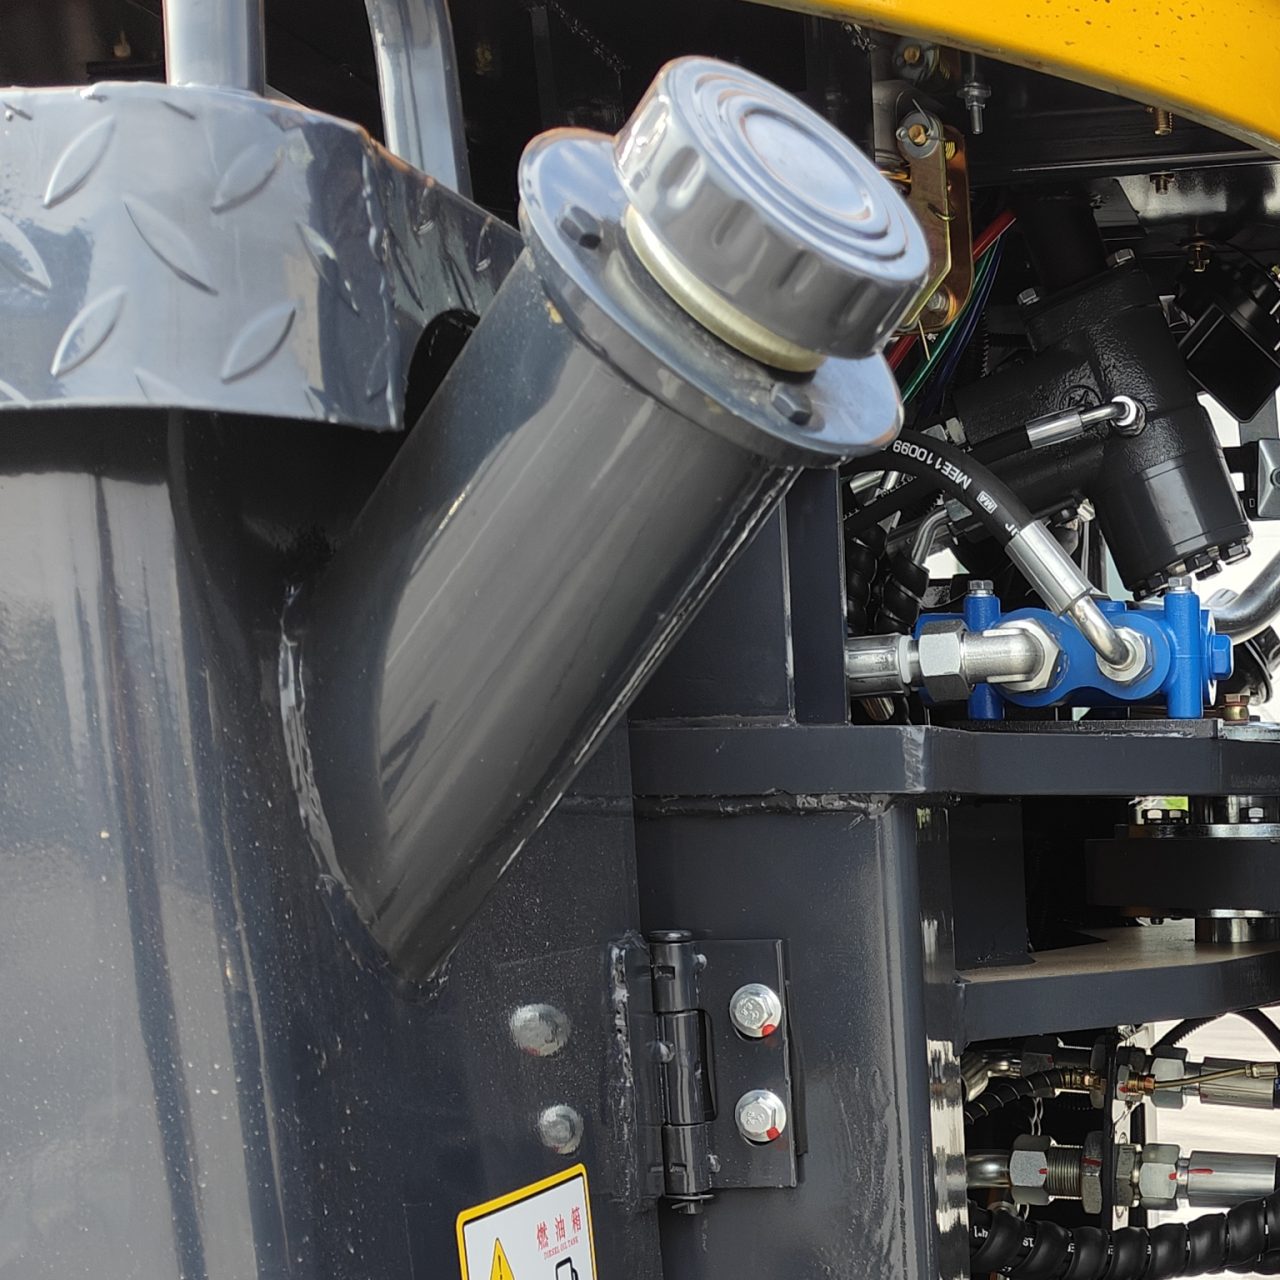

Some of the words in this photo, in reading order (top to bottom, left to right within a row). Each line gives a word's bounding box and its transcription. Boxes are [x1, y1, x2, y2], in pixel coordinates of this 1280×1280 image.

[893, 440, 972, 490] MEE110099
[537, 1206, 581, 1251] 燃油箱
